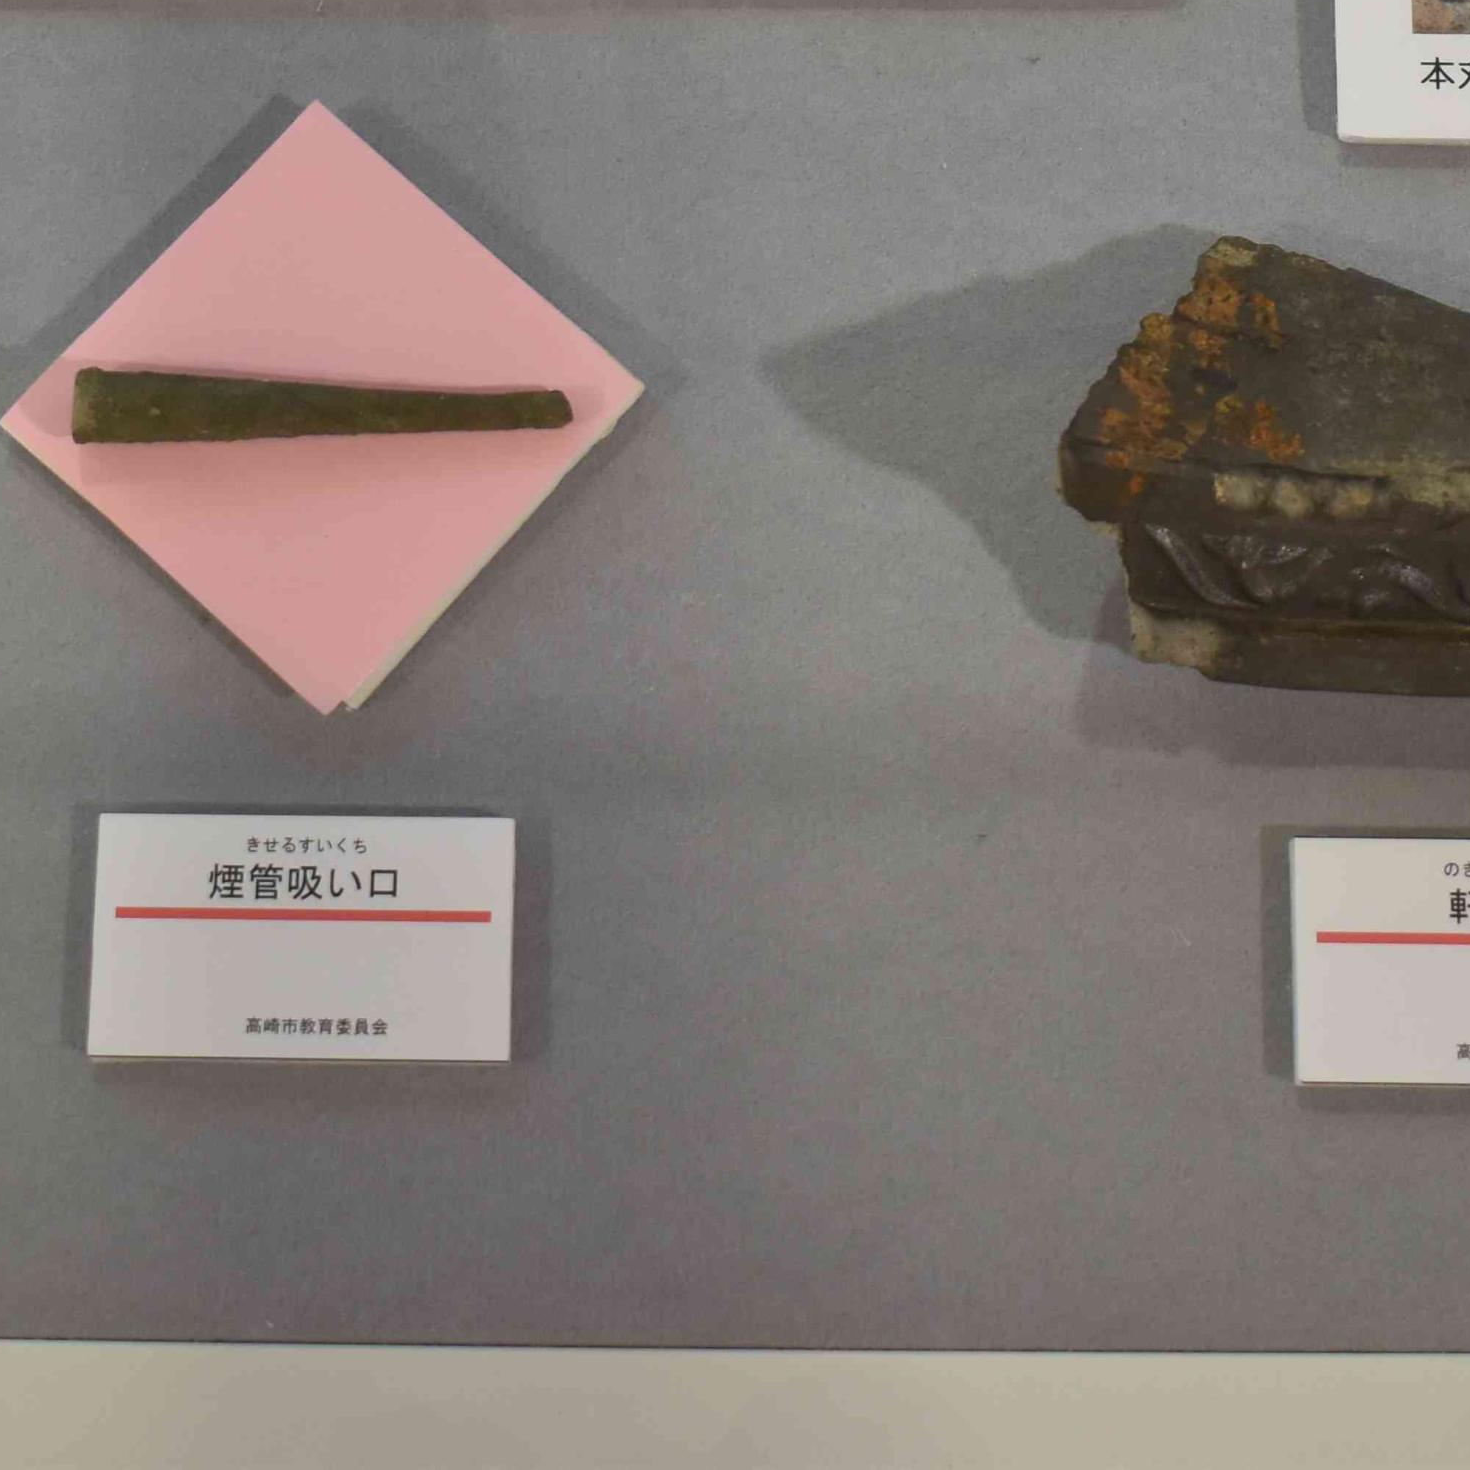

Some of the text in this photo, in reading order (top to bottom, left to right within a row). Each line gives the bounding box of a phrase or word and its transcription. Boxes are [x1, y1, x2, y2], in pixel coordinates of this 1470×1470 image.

[247, 836, 367, 855] きせるすいくち
[208, 863, 398, 900] 煙管吸い口
[246, 1017, 387, 1036] 高崎市教育委員会
